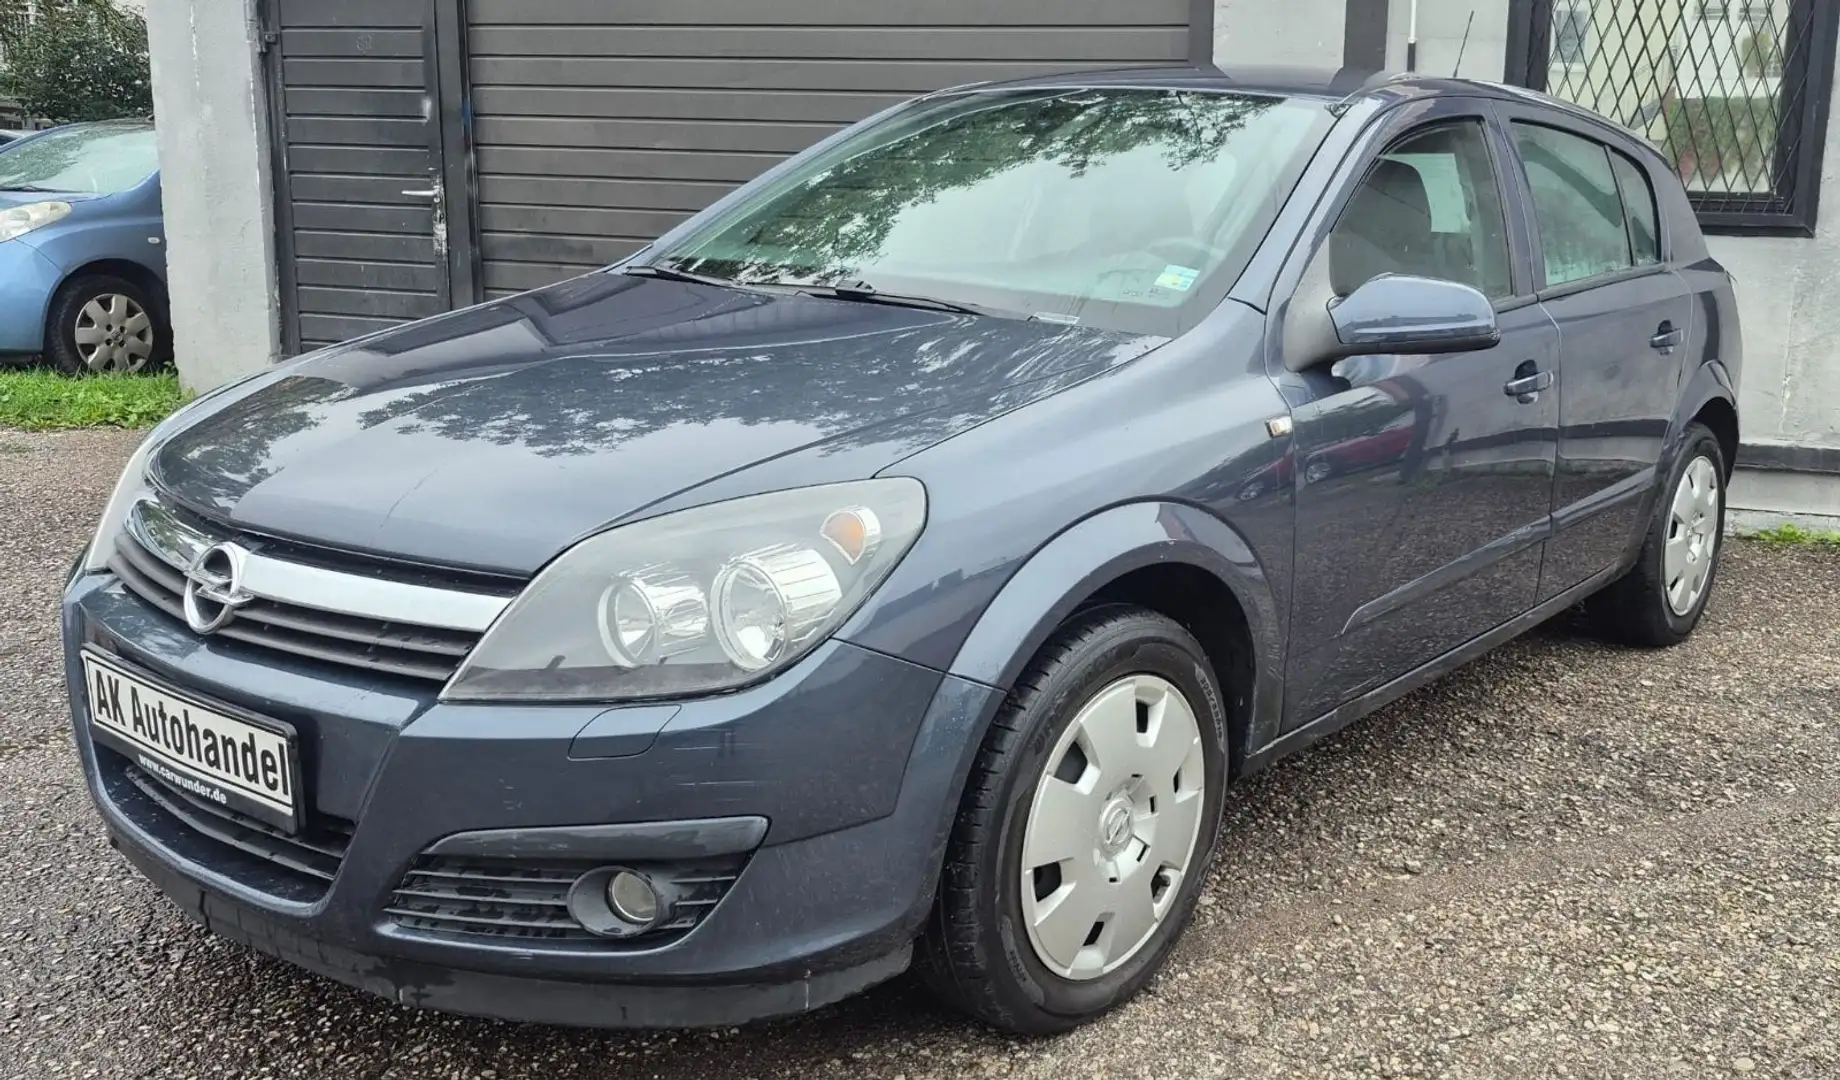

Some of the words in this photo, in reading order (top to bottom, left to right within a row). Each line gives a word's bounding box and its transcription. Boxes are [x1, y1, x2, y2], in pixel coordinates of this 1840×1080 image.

[95, 669, 126, 727] AK
[131, 686, 289, 796] Autohandel
[137, 753, 228, 805] www.carwunder.de
